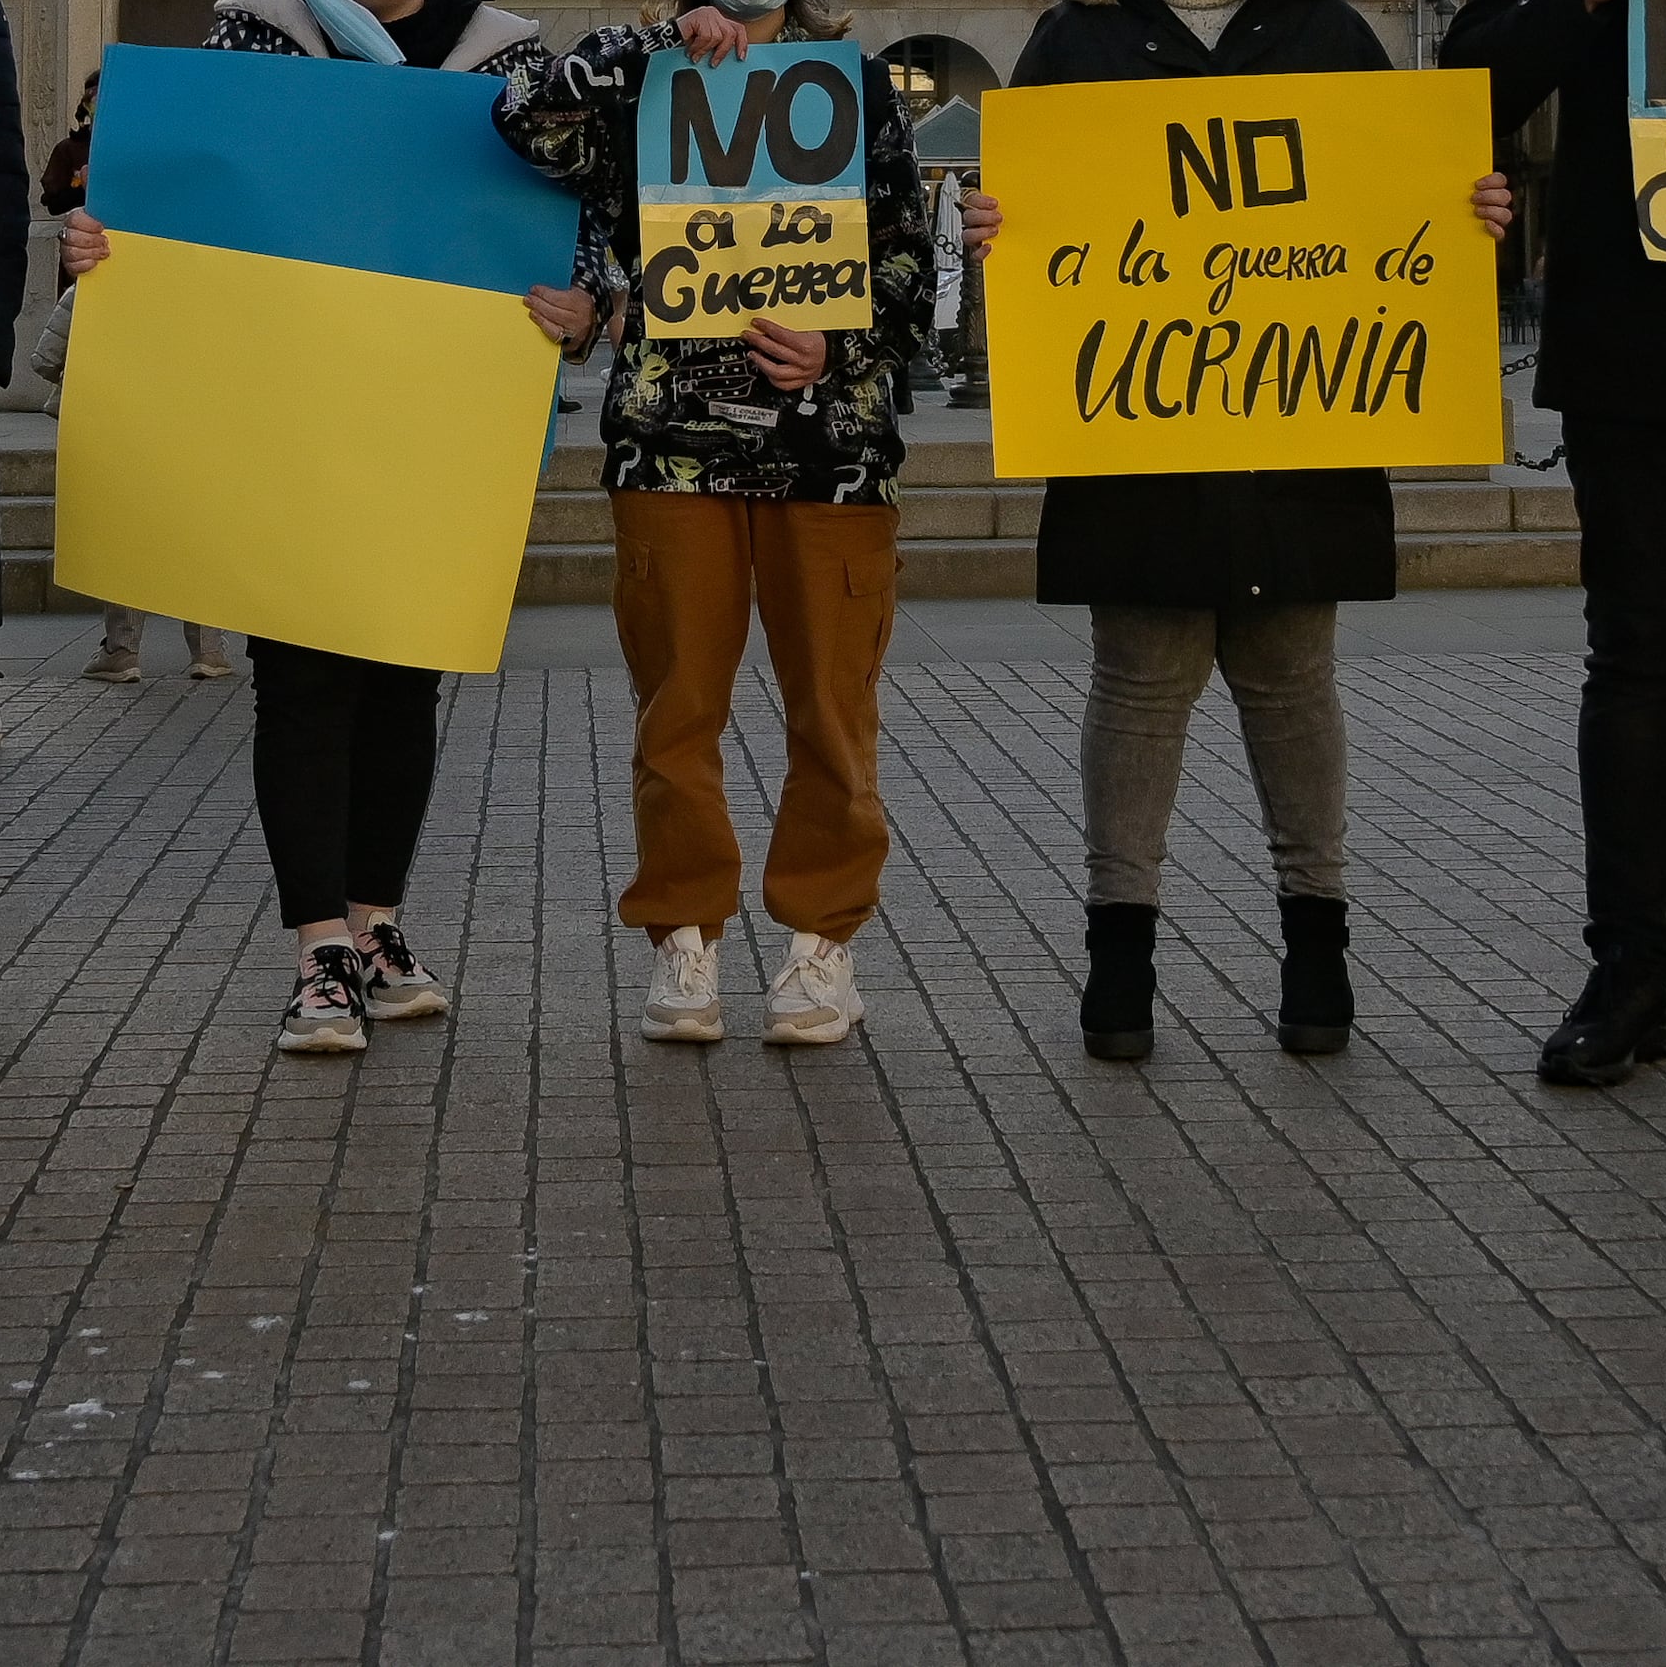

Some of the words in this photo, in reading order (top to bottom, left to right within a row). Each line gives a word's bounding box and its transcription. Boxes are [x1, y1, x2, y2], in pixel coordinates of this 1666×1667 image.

[670, 60, 859, 187] NO
[1166, 117, 1308, 218] NO
[685, 209, 737, 251] a
[1047, 242, 1091, 287] a
[1118, 219, 1171, 287] la
[1203, 242, 1349, 316] guerra
[1375, 221, 1433, 286] de
[1075, 305, 1428, 424] UCRANIA
